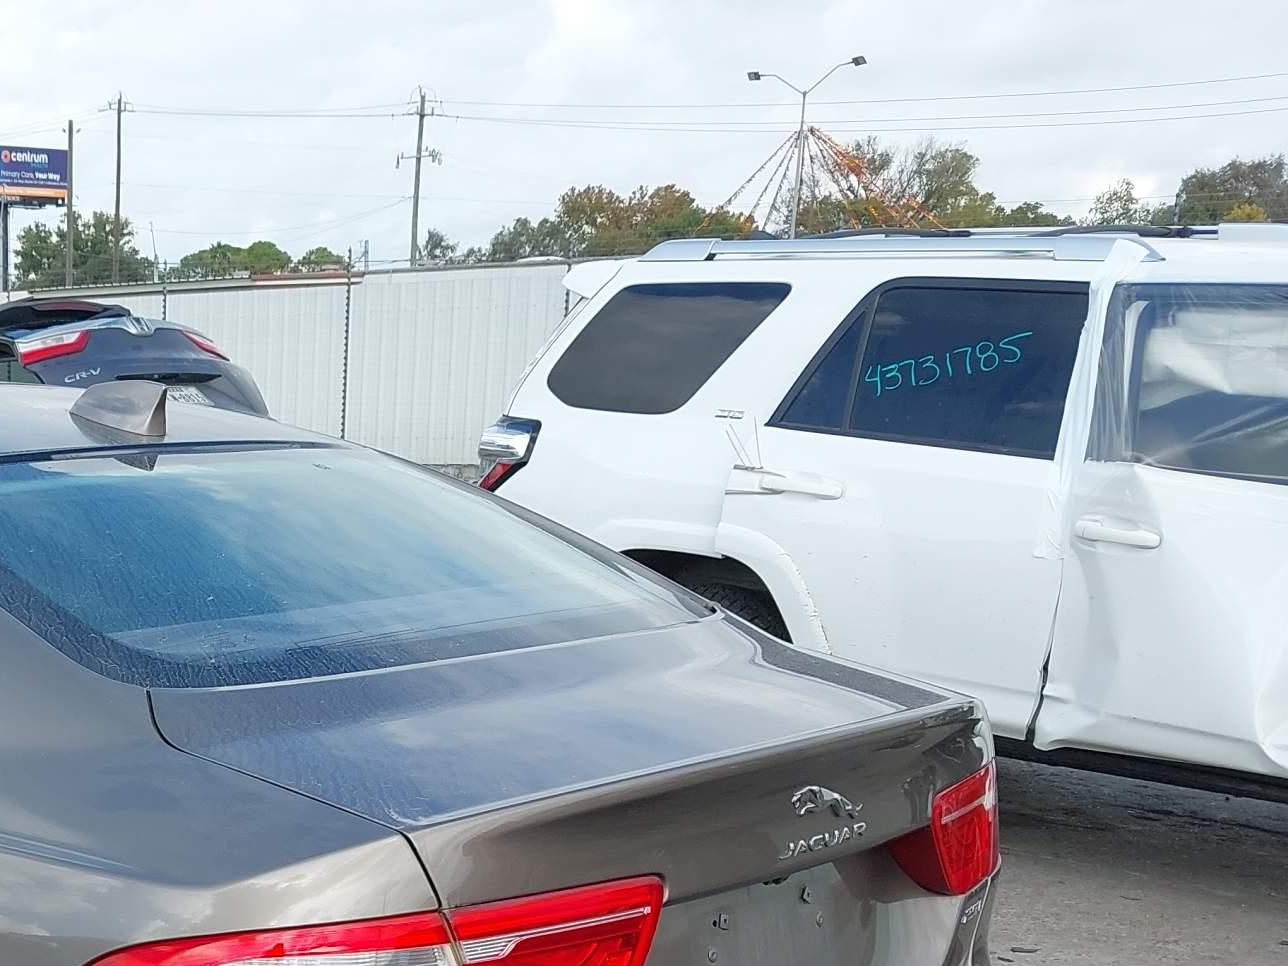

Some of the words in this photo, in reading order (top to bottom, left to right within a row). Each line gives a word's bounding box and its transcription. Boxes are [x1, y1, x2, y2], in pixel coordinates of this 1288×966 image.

[11, 150, 49, 163] centrum
[0, 170, 20, 179] Primary
[865, 331, 1033, 397] 43731785
[64, 367, 102, 384] CR-V
[778, 822, 867, 860] JAGUAR
